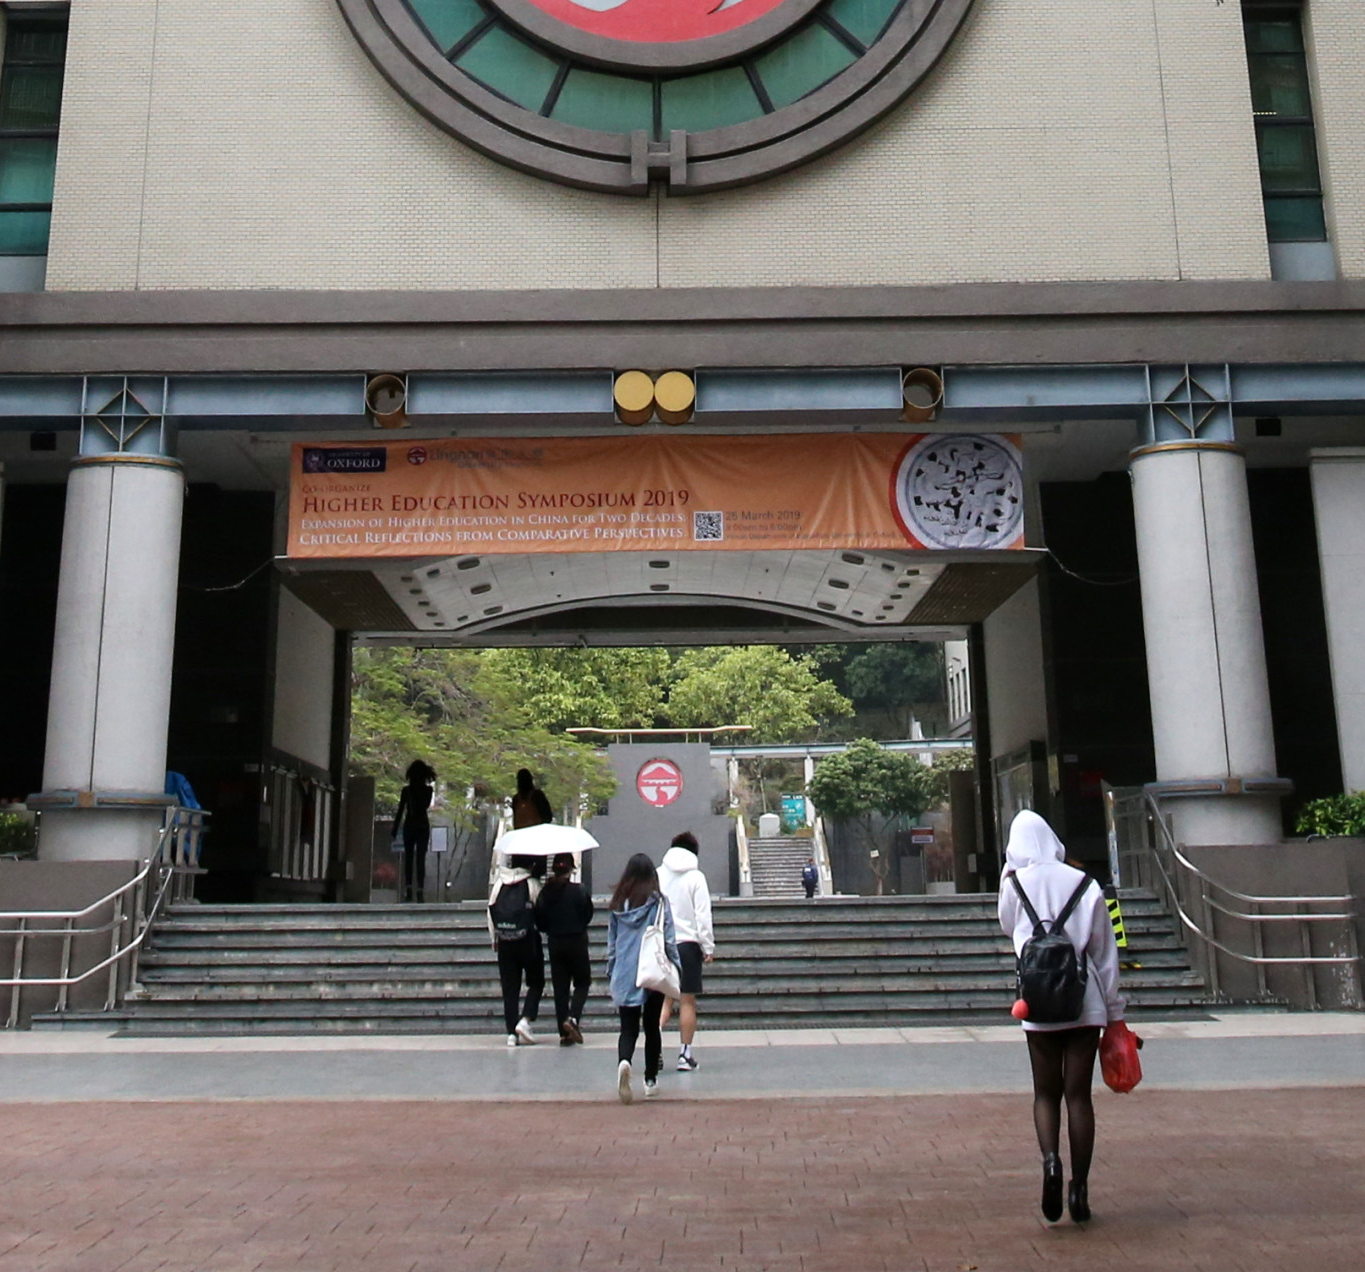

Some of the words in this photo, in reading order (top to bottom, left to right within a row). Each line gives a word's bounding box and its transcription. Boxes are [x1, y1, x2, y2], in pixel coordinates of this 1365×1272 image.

[327, 458, 381, 469] OXFORD
[303, 496, 384, 514] HIGHER
[391, 494, 509, 512] EDUCATION
[517, 491, 636, 510] SYMPOSIUM
[643, 489, 690, 507] 2019
[301, 518, 365, 530] EXPANSION
[368, 518, 384, 528] OF
[388, 516, 435, 528] HIGHER
[439, 515, 505, 527] EDUCATION
[511, 516, 524, 525] IN
[528, 513, 568, 525] CHINA
[572, 513, 596, 524] FOR
[599, 512, 627, 524] TWO
[741, 510, 775, 521] March
[777, 510, 801, 521] 2019
[299, 531, 360, 546] CRITICAL
[365, 531, 452, 544] REFLECTIONS
[456, 531, 494, 542] FROM
[497, 528, 590, 541] COMPARATIVE
[594, 526, 684, 539] PERSPECTIVES
